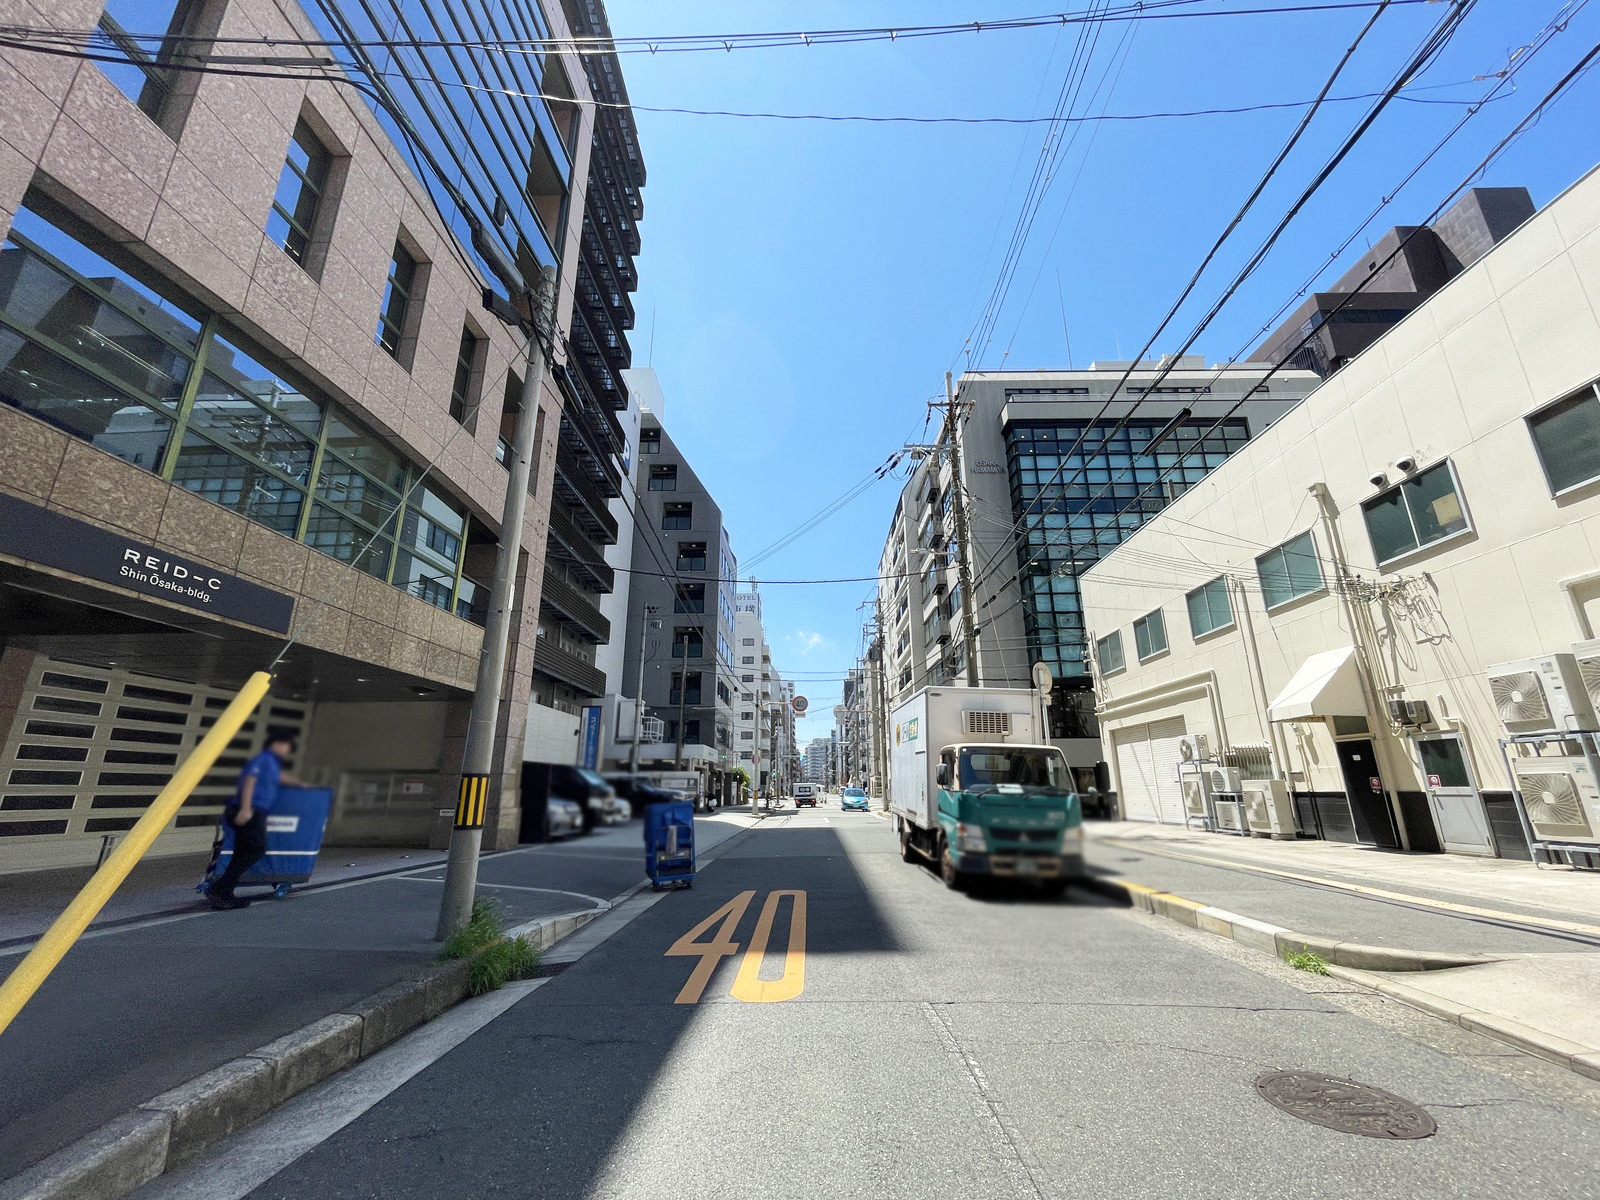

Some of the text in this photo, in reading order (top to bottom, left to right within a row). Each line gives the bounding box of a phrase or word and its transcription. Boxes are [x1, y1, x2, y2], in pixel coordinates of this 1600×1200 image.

[119, 565, 212, 602] Shin Ōsaka-bldg.
[123, 548, 222, 590] REID-C
[796, 700, 805, 708] 40
[663, 889, 807, 1004] 40
